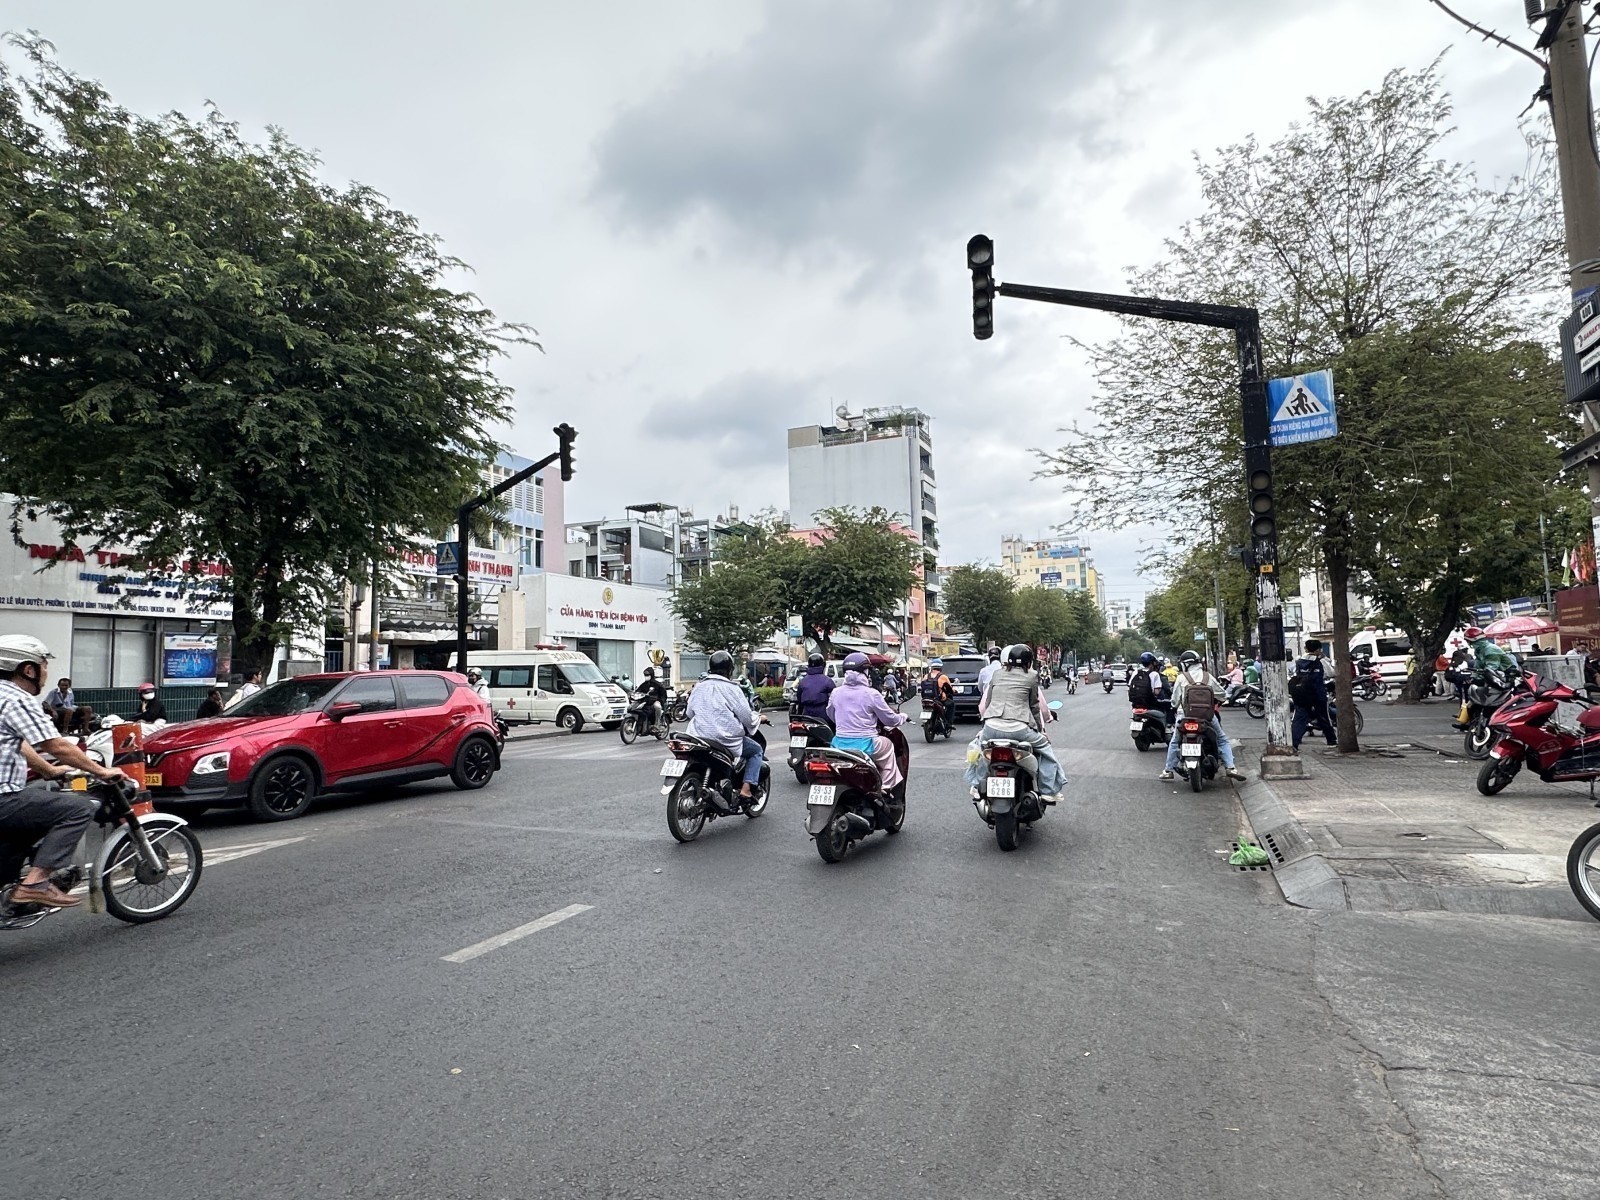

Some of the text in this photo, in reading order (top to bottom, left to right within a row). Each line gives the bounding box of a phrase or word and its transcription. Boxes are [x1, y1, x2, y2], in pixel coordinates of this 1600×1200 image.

[483, 563, 513, 578] THẠNH
[560, 604, 647, 624] CỬA HÀNG TIỆN ÍCH BỆNH VIỆN
[813, 786, 832, 795] 59-S3
